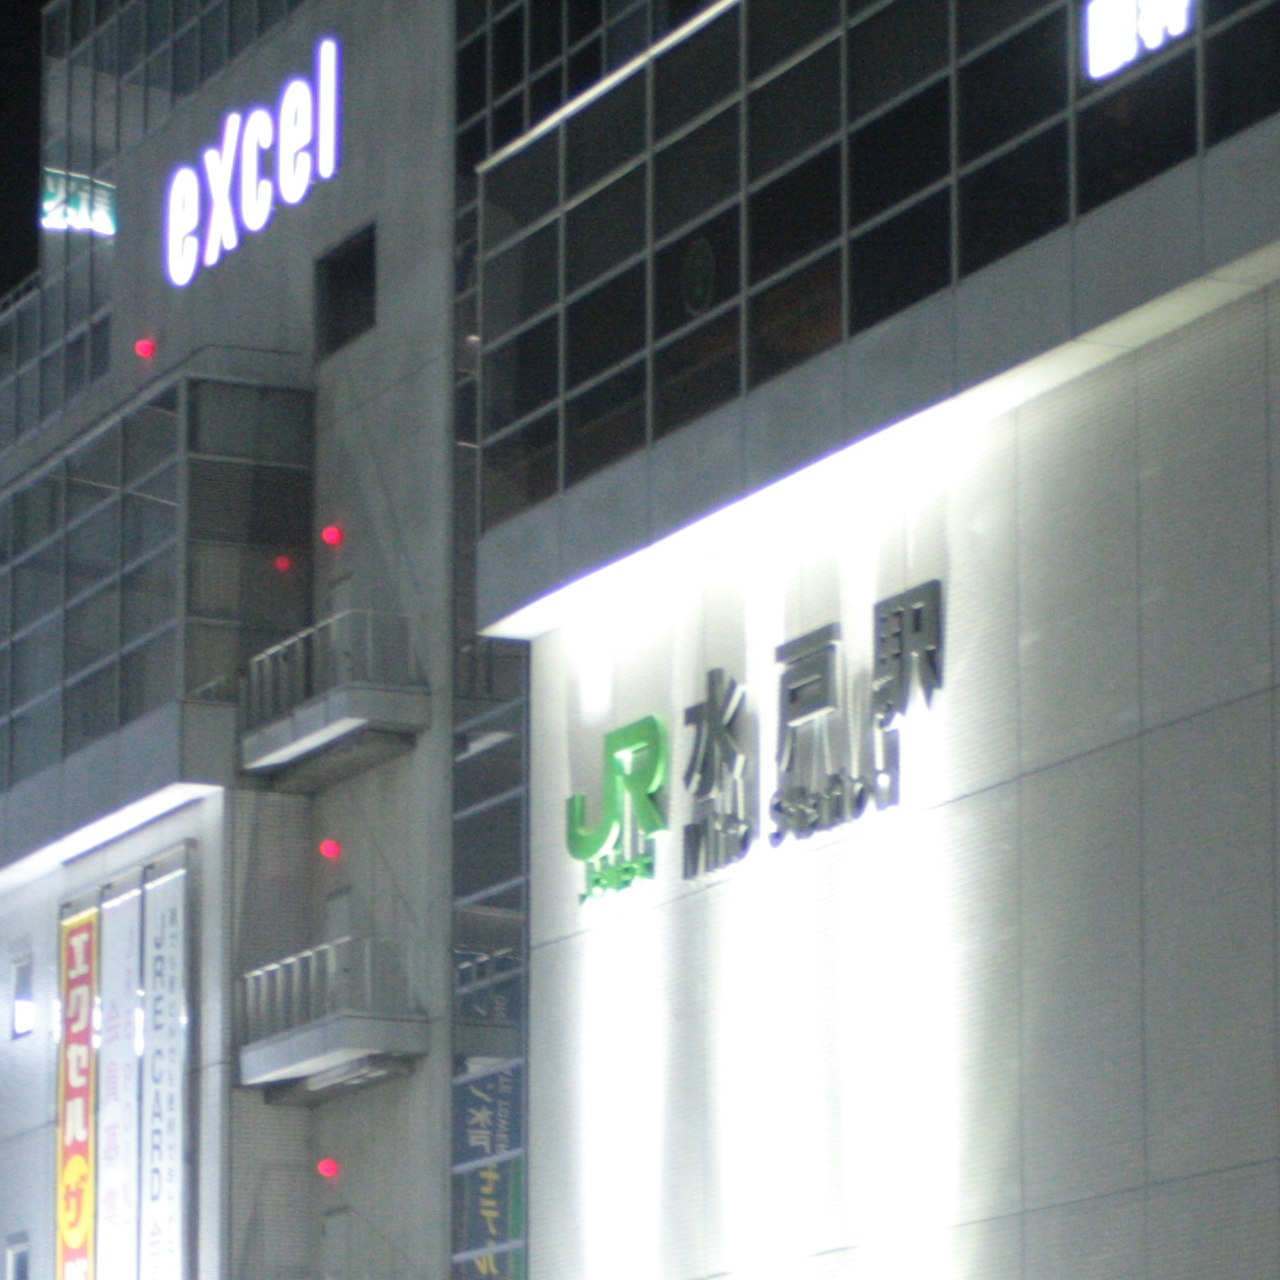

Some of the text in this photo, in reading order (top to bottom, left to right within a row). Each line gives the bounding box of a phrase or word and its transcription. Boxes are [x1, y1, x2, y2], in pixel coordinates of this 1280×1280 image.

[166, 37, 340, 287] excel
[565, 579, 944, 862] JR 水戸駅
